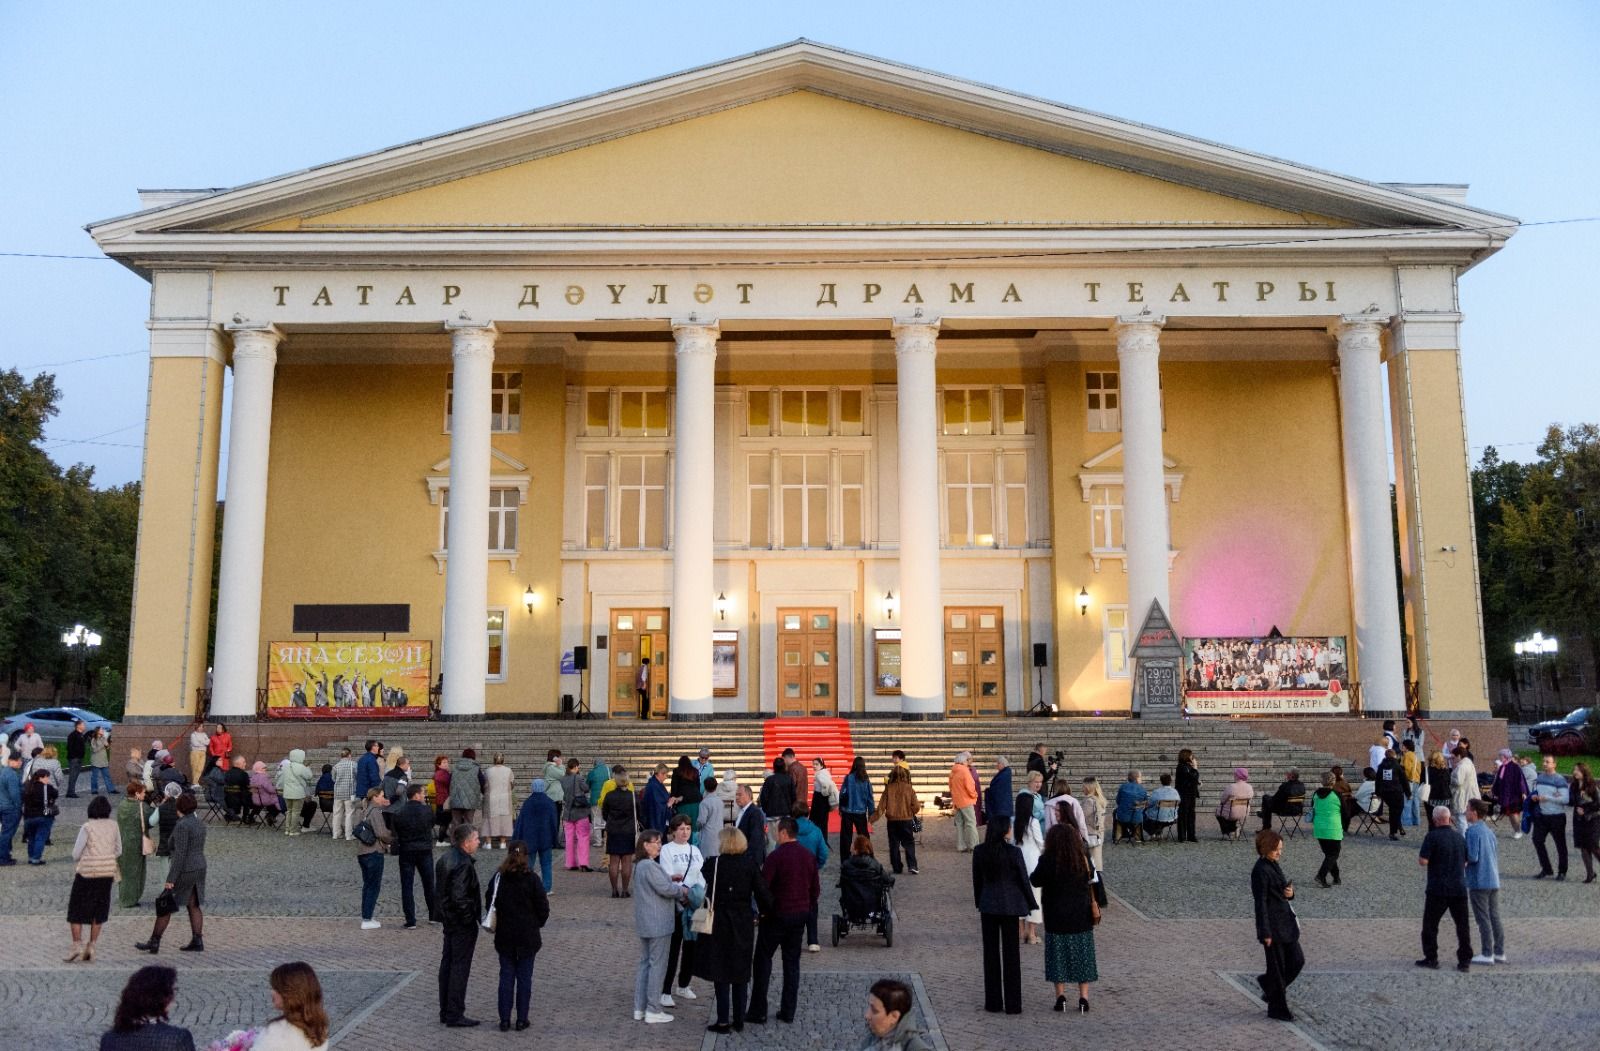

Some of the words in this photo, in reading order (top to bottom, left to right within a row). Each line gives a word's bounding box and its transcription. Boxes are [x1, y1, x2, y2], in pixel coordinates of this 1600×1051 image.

[273, 285, 461, 307] ТАТАР
[517, 283, 753, 309] ДӘҮЛӘТ
[816, 282, 1023, 308] ДРАМА
[1084, 281, 1337, 304] ТЕАТРЫ
